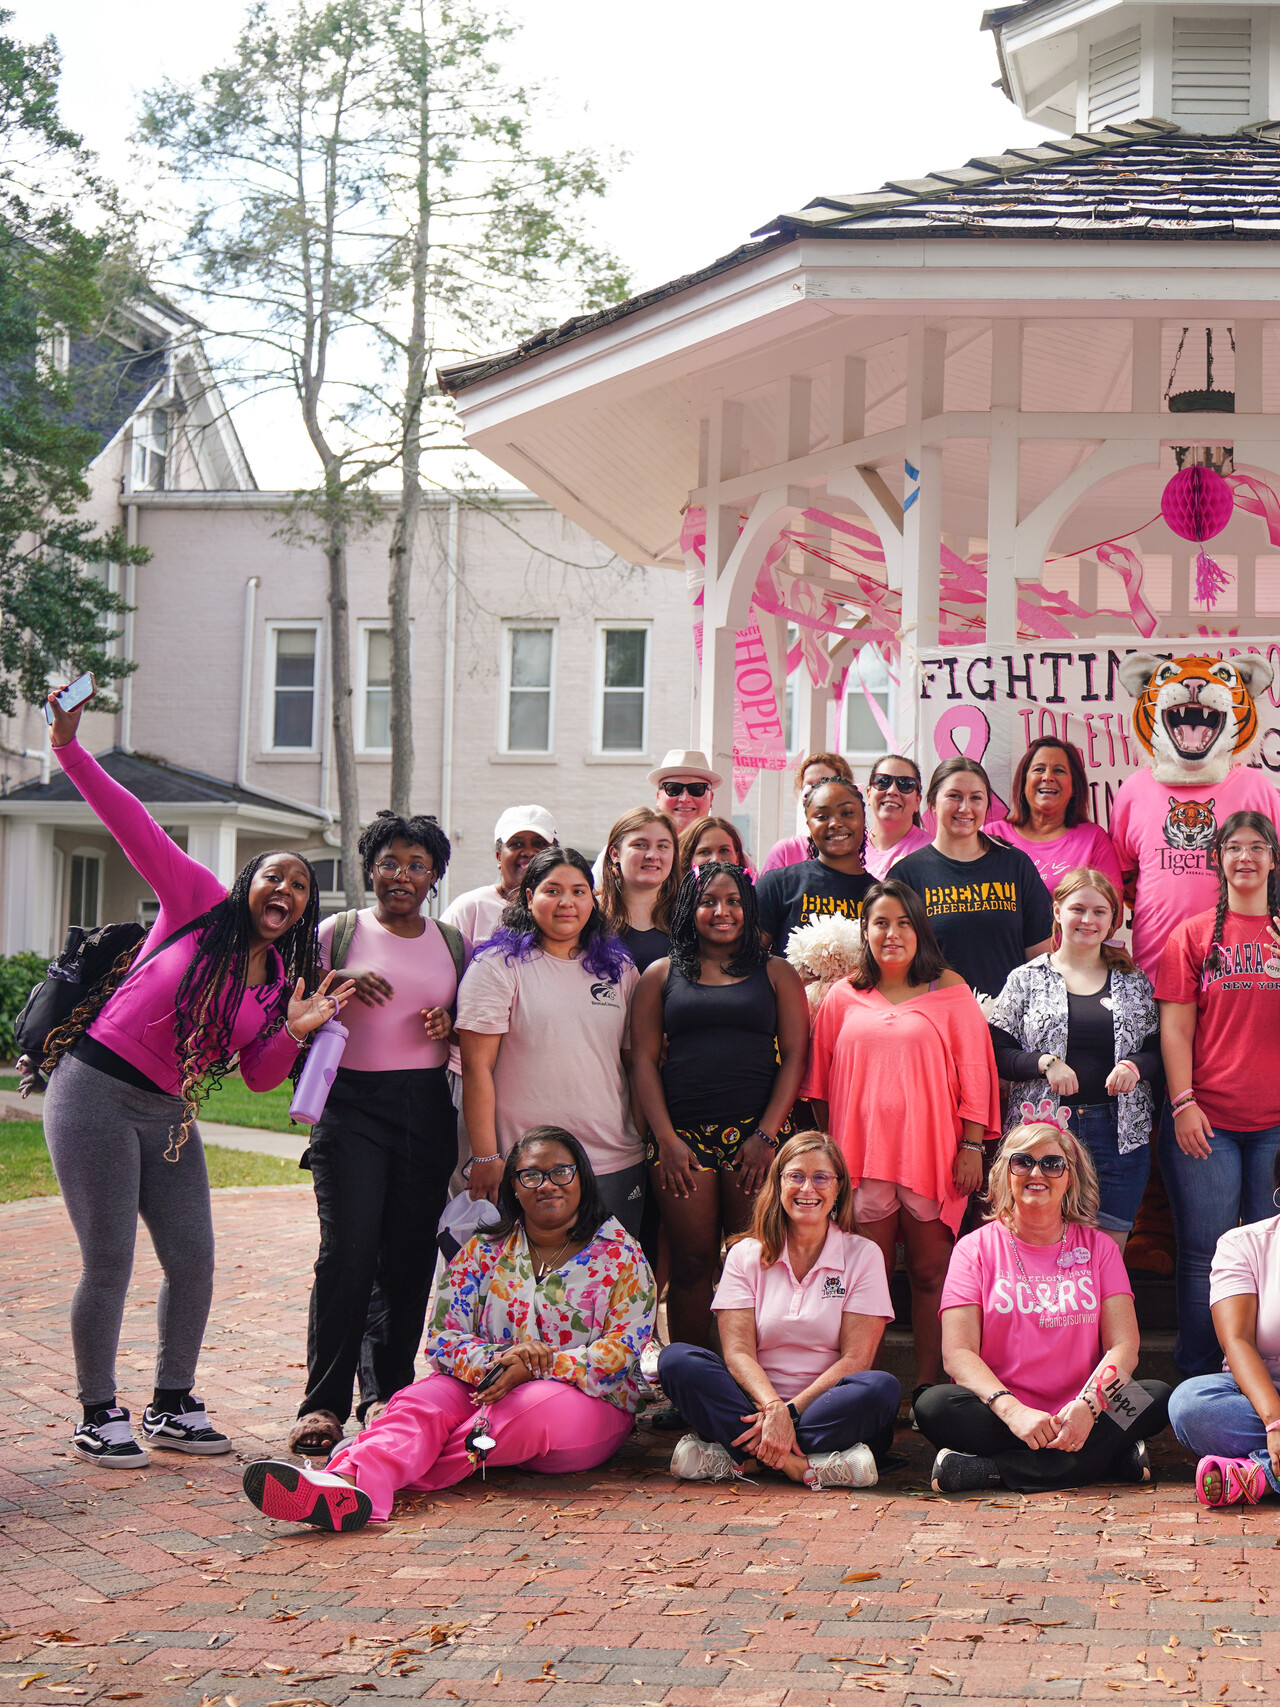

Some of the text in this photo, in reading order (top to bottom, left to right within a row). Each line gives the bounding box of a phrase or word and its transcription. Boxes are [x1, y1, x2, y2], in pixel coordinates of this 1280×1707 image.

[920, 649, 1174, 703] FIGHTIN
[735, 634, 782, 740] HOPE
[925, 881, 1017, 906] BRENAU
[926, 900, 1017, 917] CHEERLEADING
[1222, 981, 1253, 990] NEW
[1069, 1269, 1092, 1278] have
[1039, 1311, 1097, 1329] #cancersurvivor
[1105, 1378, 1137, 1417] Hope
